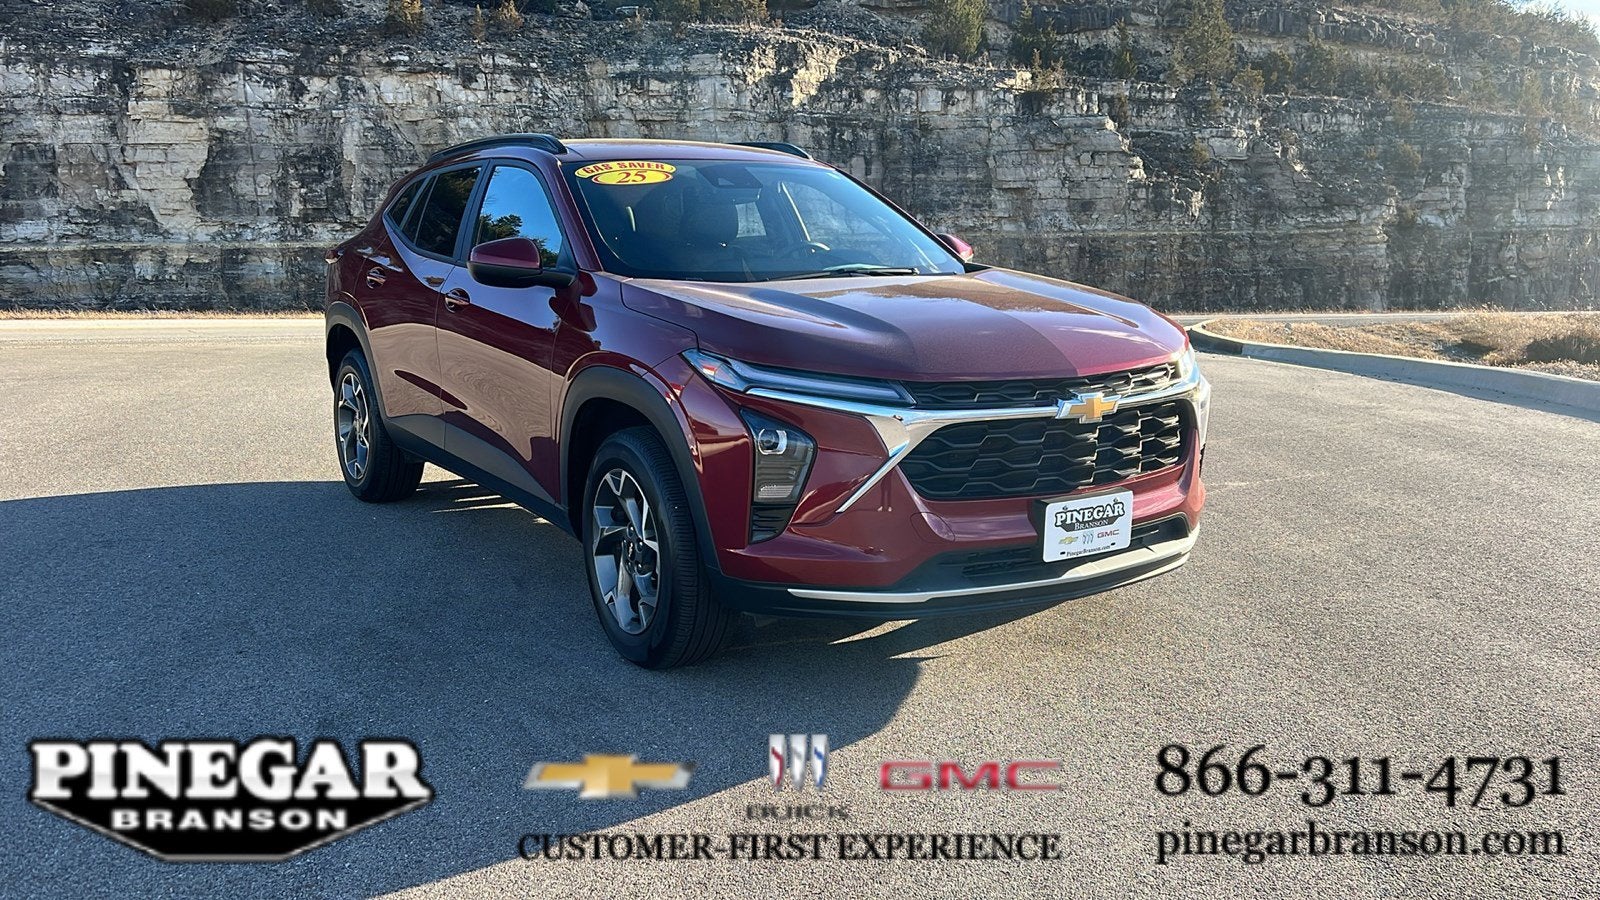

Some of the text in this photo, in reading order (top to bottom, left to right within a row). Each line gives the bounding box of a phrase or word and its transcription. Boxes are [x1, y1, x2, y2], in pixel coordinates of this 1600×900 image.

[583, 162, 664, 174] GAS SAVER
[616, 171, 648, 183] 25
[1056, 503, 1124, 526] PINEGAR
[1097, 529, 1119, 539] GMC
